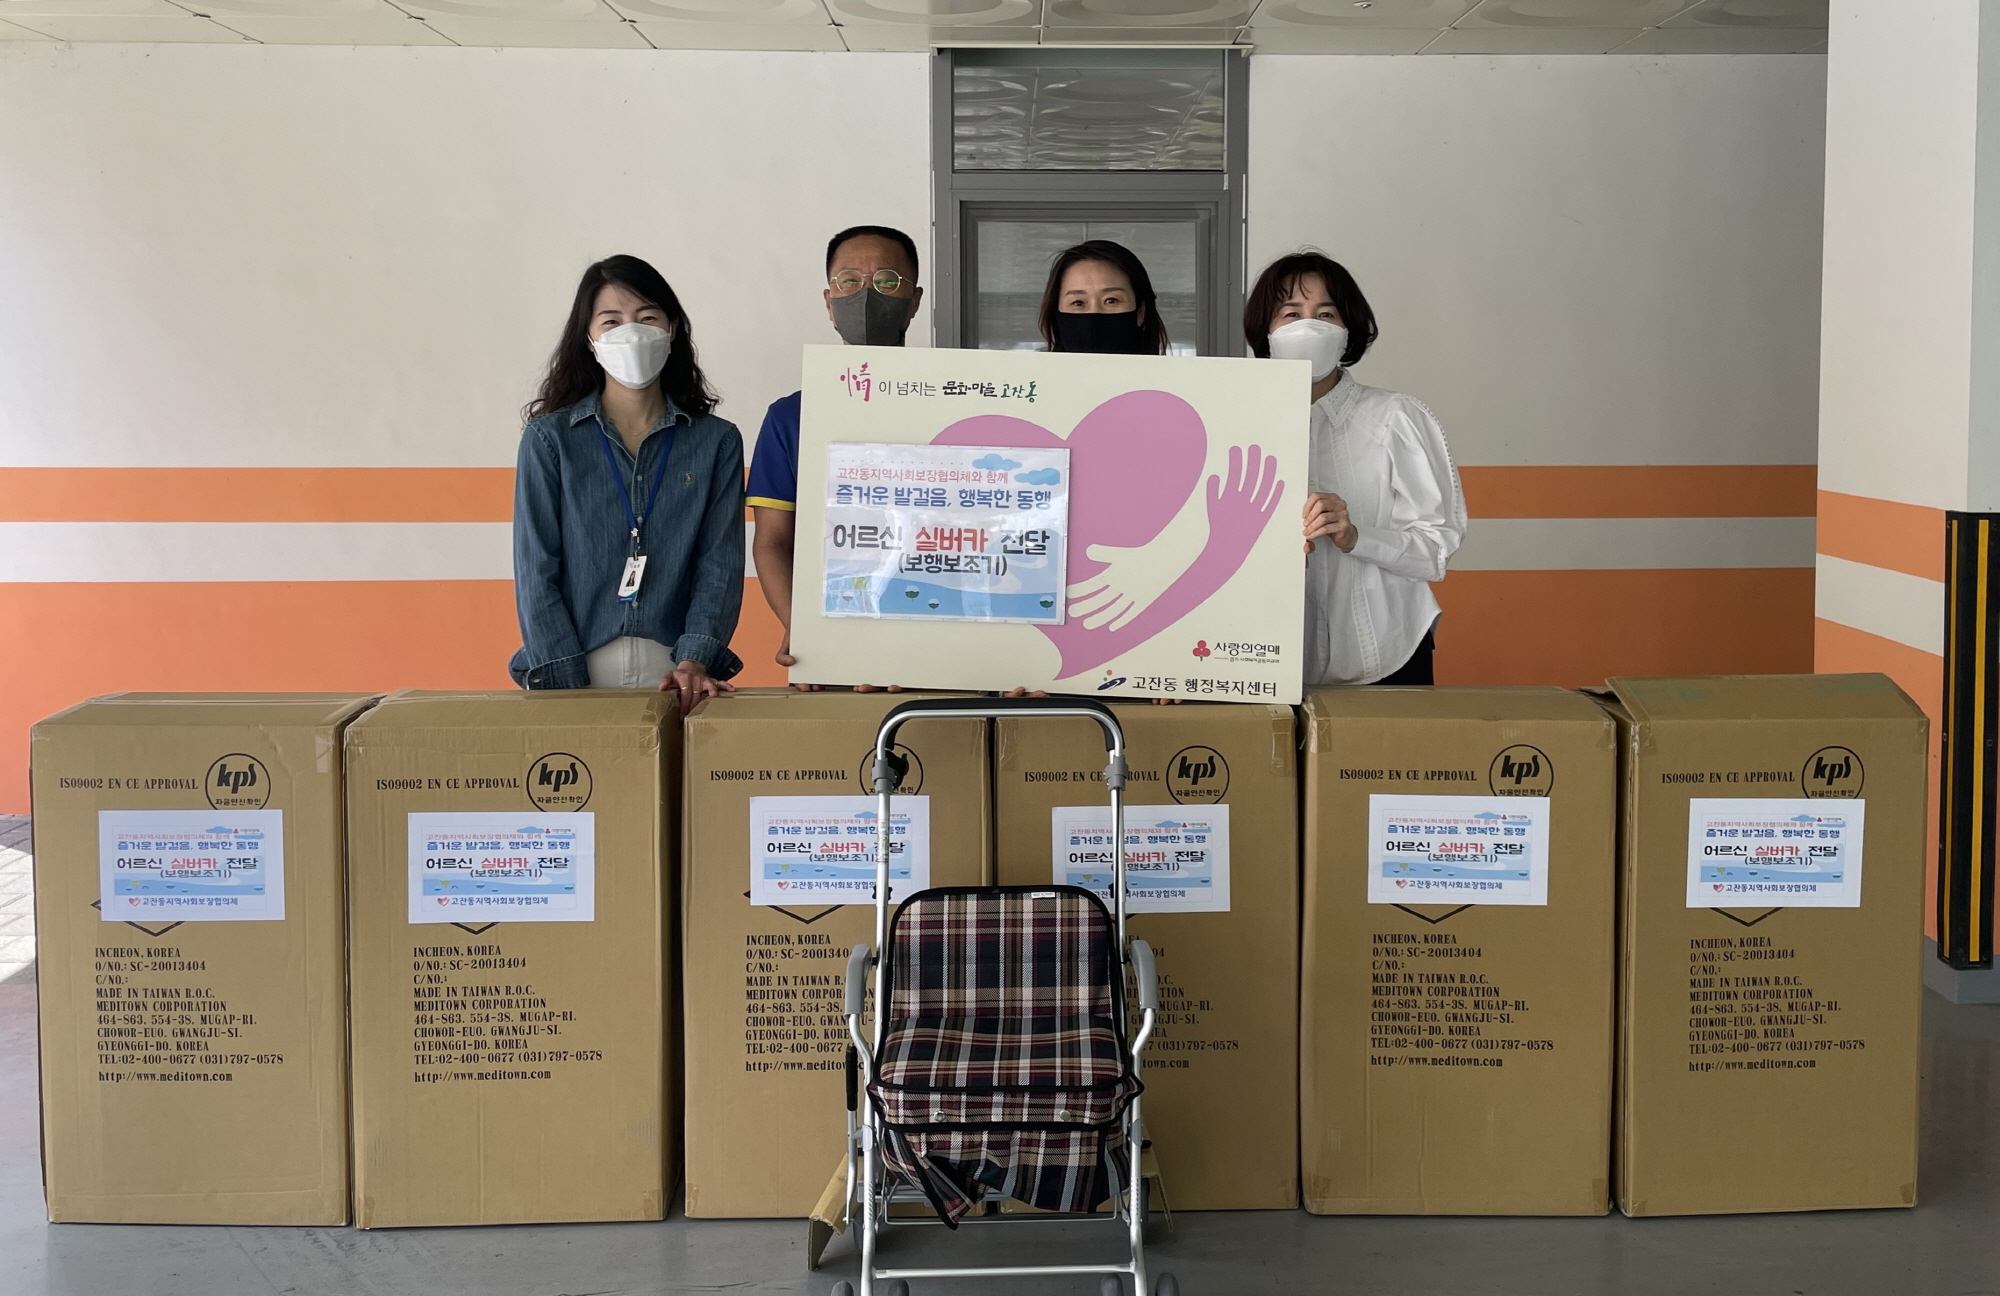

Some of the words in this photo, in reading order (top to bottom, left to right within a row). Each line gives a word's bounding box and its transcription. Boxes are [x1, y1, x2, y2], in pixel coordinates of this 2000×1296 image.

[897, 382, 936, 397] 넘치는
[1001, 381, 1037, 403] 고잔동
[837, 467, 982, 483] 고잔동지역사회보장협의체와
[987, 471, 1008, 483] 함께
[836, 485, 889, 505] 즐거운
[894, 486, 951, 508] 발걸음,
[959, 489, 1012, 508] 행복한
[1017, 490, 1051, 510] 동행
[833, 524, 902, 550] 어르신
[915, 526, 988, 552] 실버카
[1000, 529, 1050, 555] 전달
[898, 554, 1008, 576] (보행보조기)
[1214, 642, 1280, 657] 사랑의열매
[1132, 677, 1178, 691] 고잔동
[1184, 679, 1276, 696] 행정복지센터
[760, 771, 771, 780] EN
[777, 770, 790, 780] CE
[795, 770, 847, 780] APPROVAL
[1073, 772, 1084, 781] EN
[1389, 770, 1401, 780] EN
[1407, 770, 1419, 780] CE
[1424, 771, 1477, 781] APPROVAL
[1710, 773, 1721, 783] EN
[1727, 772, 1739, 782] CE
[1744, 772, 1795, 782] APPROVAL
[109, 779, 120, 789] EN
[126, 779, 139, 789] CE
[145, 779, 198, 789] APPROVAL
[428, 779, 440, 789] EN
[447, 779, 459, 789] CE
[465, 778, 519, 788] APPROVAL
[767, 843, 811, 853] 어르신
[820, 843, 866, 853] 실버카
[1386, 841, 1430, 852] 어르신
[1439, 843, 1485, 853] 실버카
[1493, 843, 1525, 854] 전달
[1705, 845, 1747, 856] 어르신
[1755, 846, 1800, 856] 실버카
[1808, 846, 1839, 857] 전달
[1175, 851, 1206, 862] 전달
[117, 857, 162, 869] 어르신
[171, 858, 218, 869] 실버카
[226, 857, 258, 869] 전달
[426, 858, 472, 869] 어르신
[481, 858, 529, 868] 실버카
[537, 857, 569, 869] 전달
[798, 935, 830, 944] KOREA
[1424, 934, 1456, 944] KOREA
[1740, 937, 1771, 947] KOREA
[147, 948, 180, 957] KOREA
[467, 945, 501, 956] KOREA
[1407, 948, 1481, 957] SC-20013404
[1723, 949, 1794, 961] SC-20013404
[131, 961, 205, 971] SC-20013404
[450, 958, 525, 970] SC-20013404
[1372, 973, 1398, 983] MADE
[1404, 974, 1413, 983] IN
[1418, 974, 1455, 983] TAIWAN
[1460, 974, 1488, 984] R.O.C.
[1690, 978, 1714, 988] MADE
[1720, 978, 1729, 987] IN
[1734, 977, 1769, 987] TAIWAN
[1775, 976, 1802, 985] R.O.C.
[97, 988, 122, 998] MADE
[128, 988, 138, 998] IN
[143, 988, 180, 998] TAIWAN
[186, 988, 215, 998] R.O.C.
[414, 987, 440, 997] MADE
[447, 987, 457, 997] IN
[462, 986, 500, 997] TAIWAN
[506, 985, 535, 995] R.O.C.
[1372, 986, 1422, 996] MEDITOWN
[1428, 986, 1499, 997] CORPORATION
[1690, 991, 1738, 1001] MEDITOWN
[1743, 989, 1812, 1000] CORPORATION
[97, 1001, 147, 1011] MEDITOWN
[153, 1001, 226, 1011] CORPORATION
[415, 1000, 466, 1011] MEDITOWN
[472, 998, 545, 1009] CORPORATION
[1449, 1026, 1480, 1036] KOREA
[177, 1041, 209, 1051] KOREA
[1371, 1055, 1502, 1066] http://www.meditown.com
[1689, 1059, 1815, 1072] http://www.meditown.com
[99, 1072, 232, 1083] http://www.meditown.com
[415, 1070, 551, 1083] http://www.meditown.com
